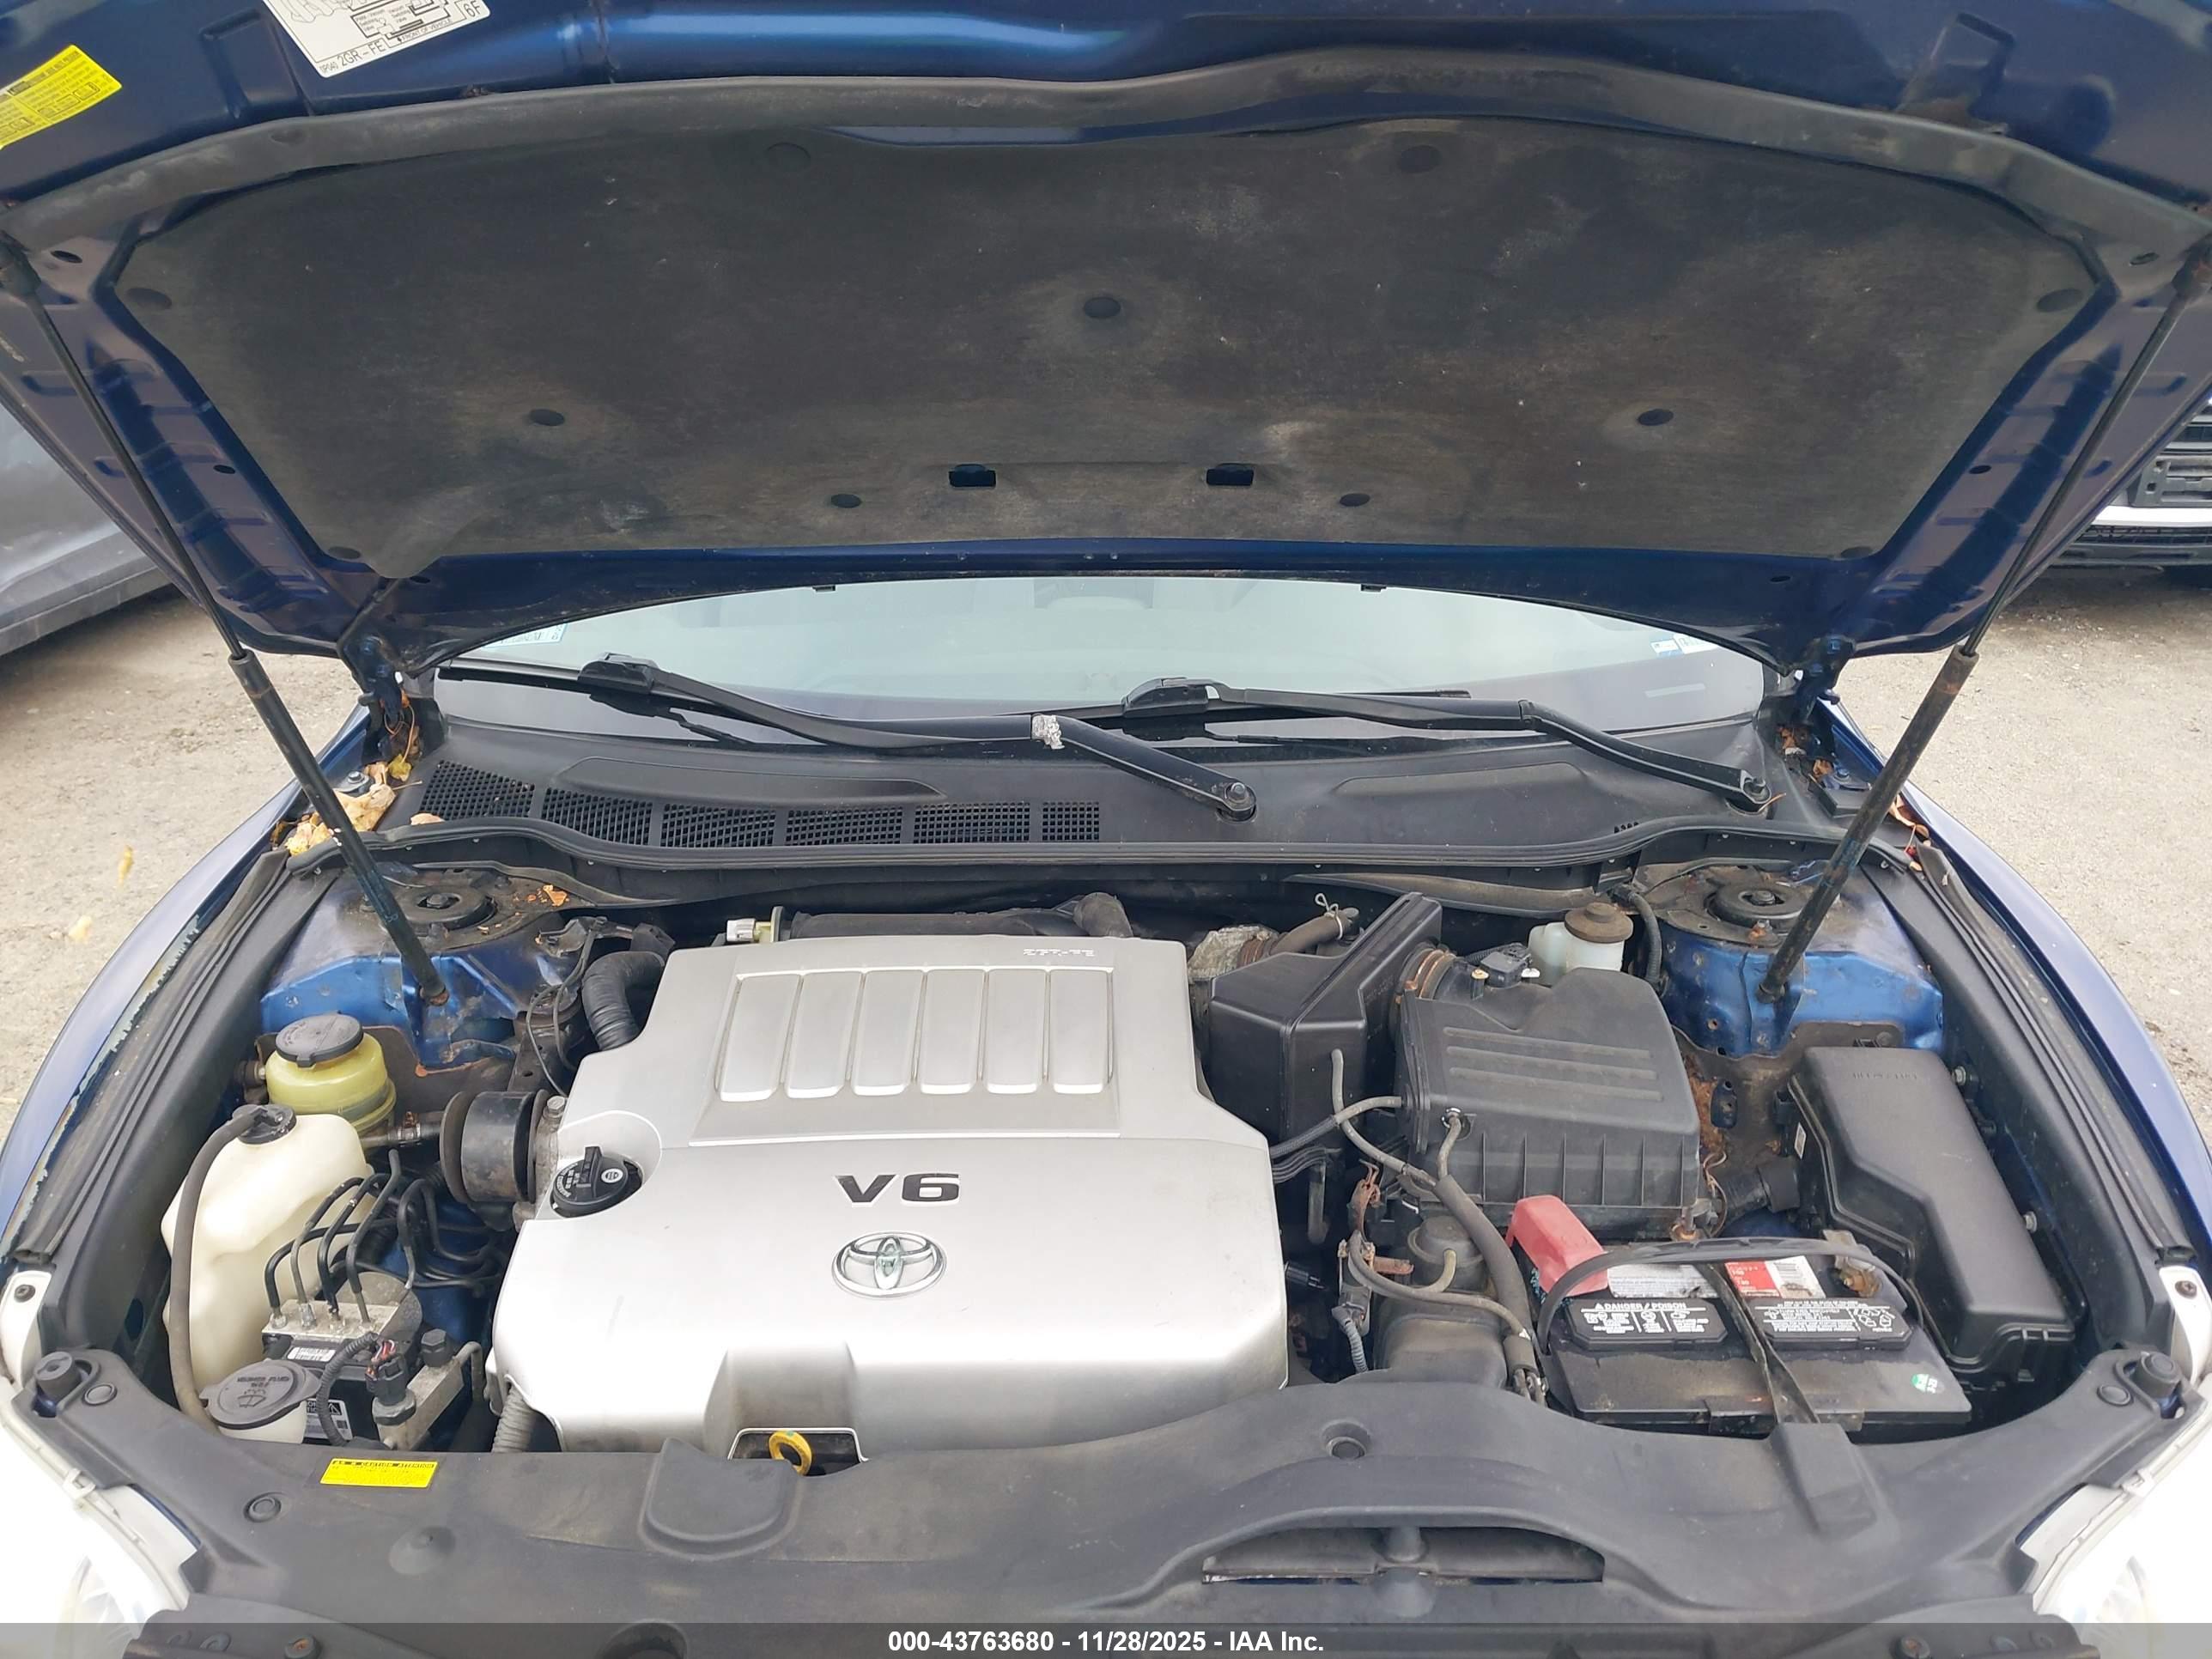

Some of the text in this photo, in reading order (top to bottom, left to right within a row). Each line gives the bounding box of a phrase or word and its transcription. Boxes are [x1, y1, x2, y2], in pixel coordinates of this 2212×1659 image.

[462, 1, 483, 18] 6F
[832, 1173, 960, 1204] V6
[1604, 1302, 1644, 1311] DANGER
[1650, 1301, 1687, 1310] POISON
